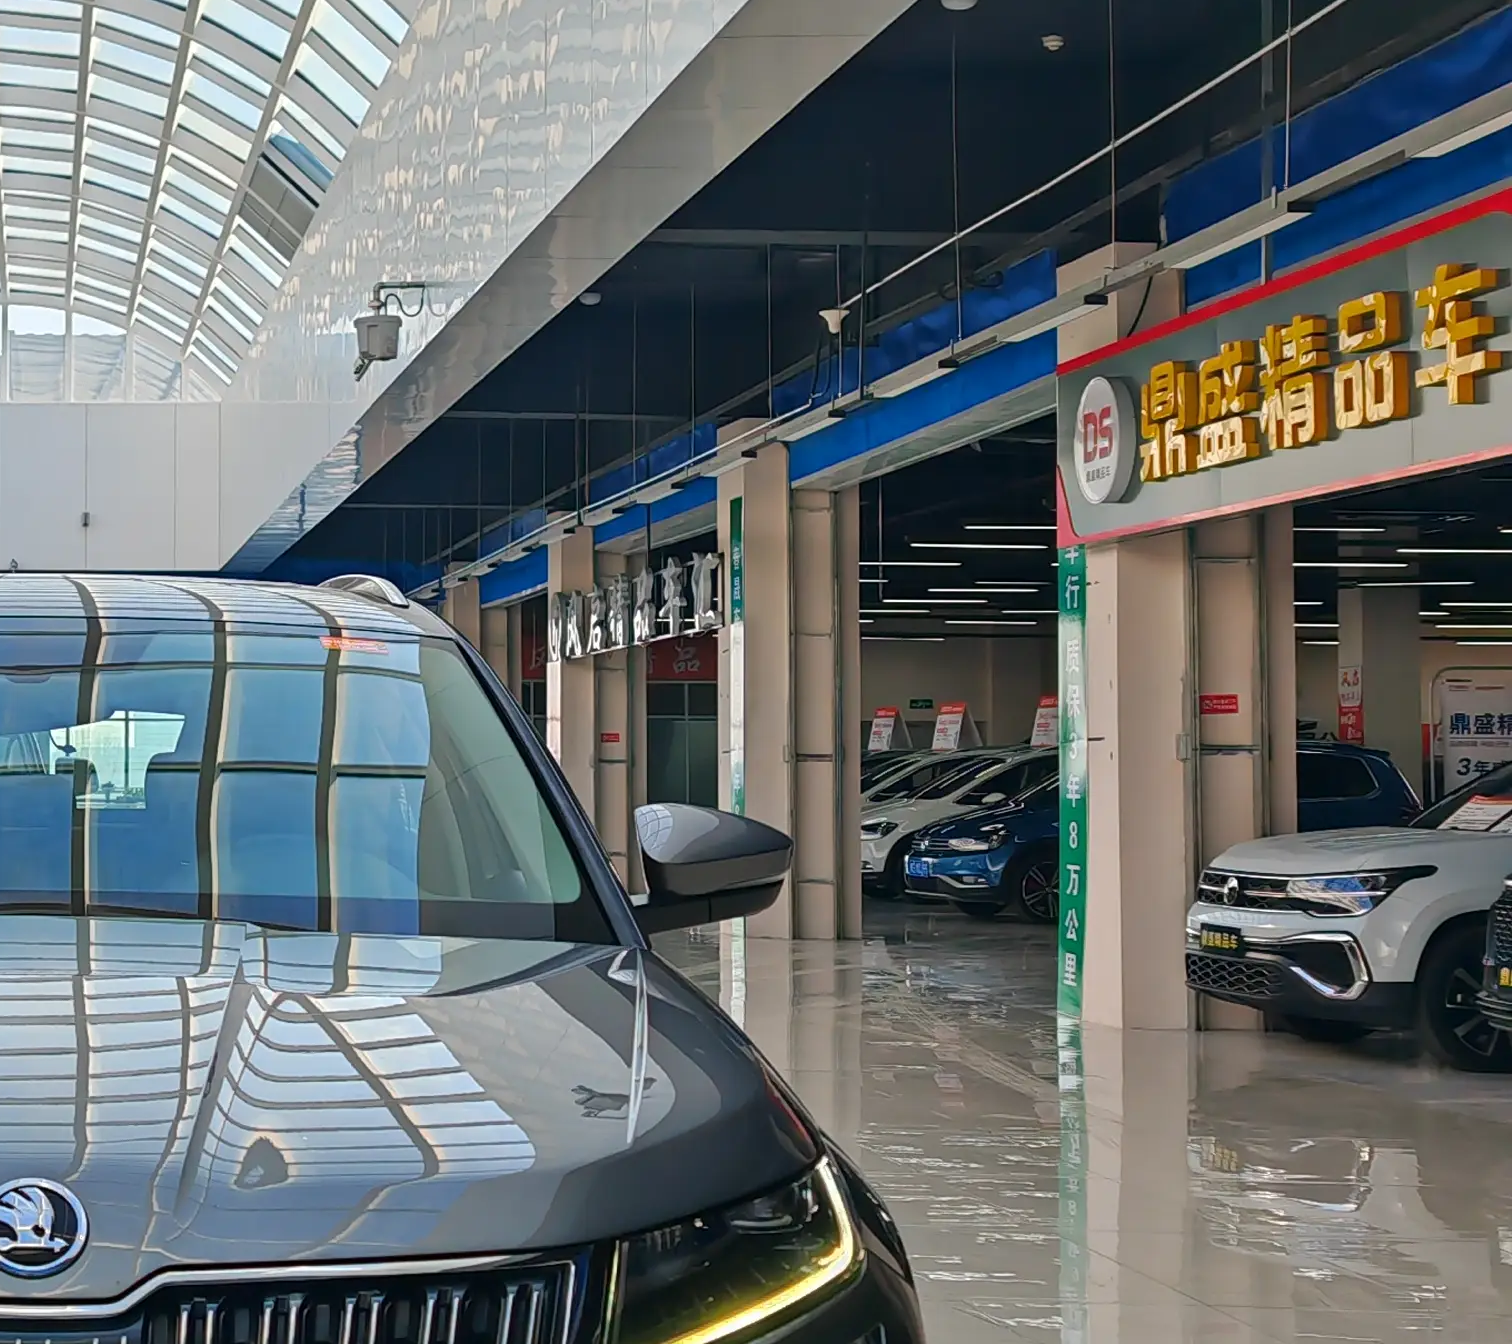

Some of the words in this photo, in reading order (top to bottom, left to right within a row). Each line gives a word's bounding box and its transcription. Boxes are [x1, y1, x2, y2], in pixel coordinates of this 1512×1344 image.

[1083, 405, 1114, 464] DS
[1139, 264, 1501, 482] 鼎盛精品车
